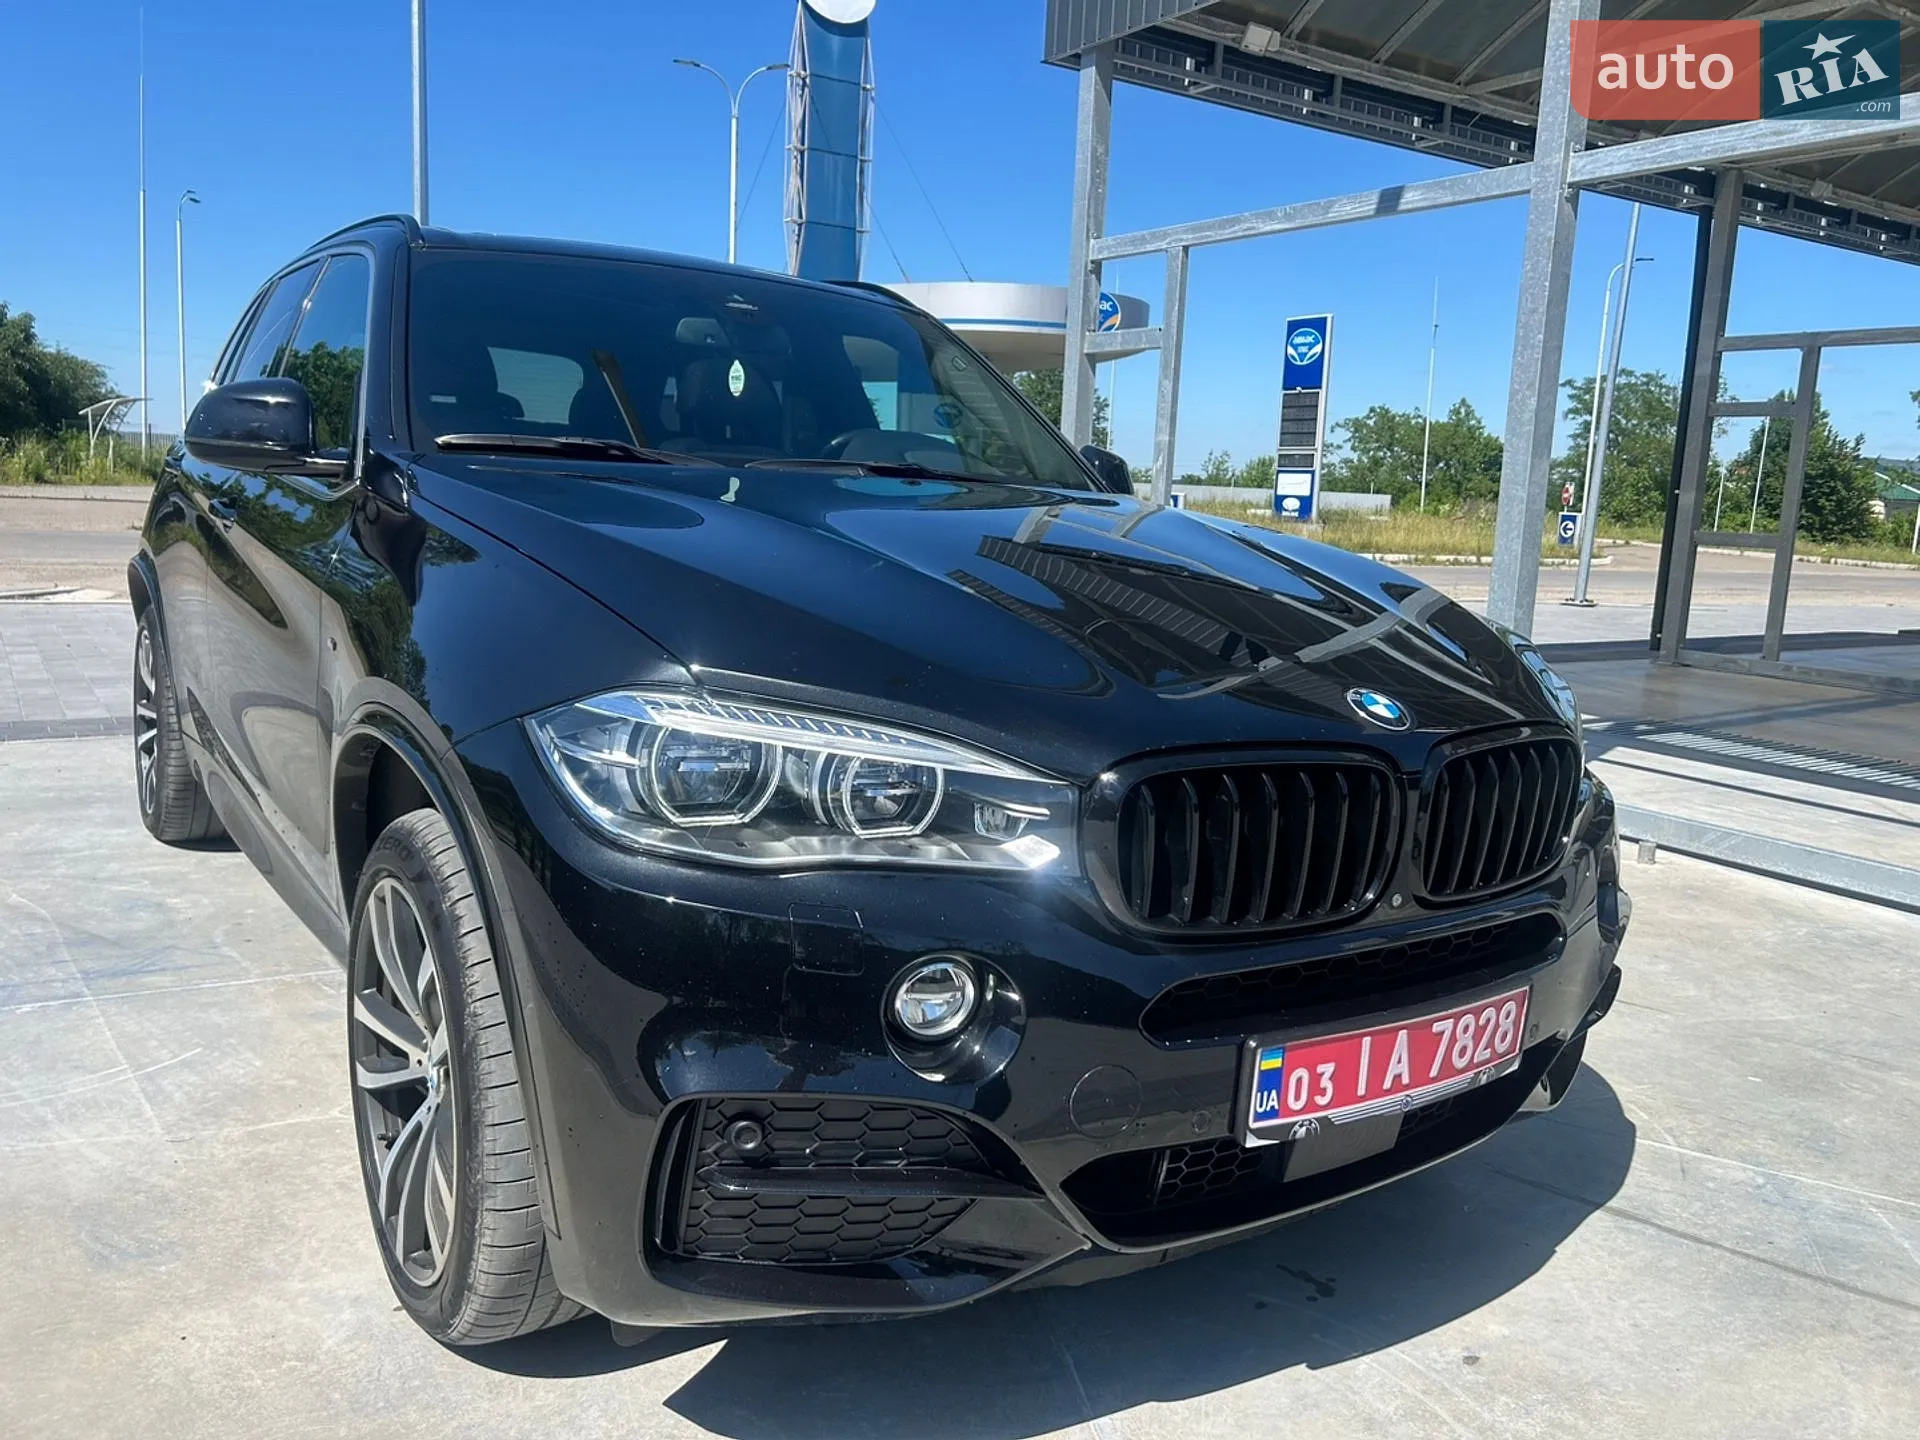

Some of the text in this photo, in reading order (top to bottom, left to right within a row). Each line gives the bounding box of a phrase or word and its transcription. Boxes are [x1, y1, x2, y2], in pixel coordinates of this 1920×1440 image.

[1287, 1061, 1336, 1112] 03
[1429, 1000, 1517, 1079] 7828
[1256, 1089, 1279, 1113] UA
